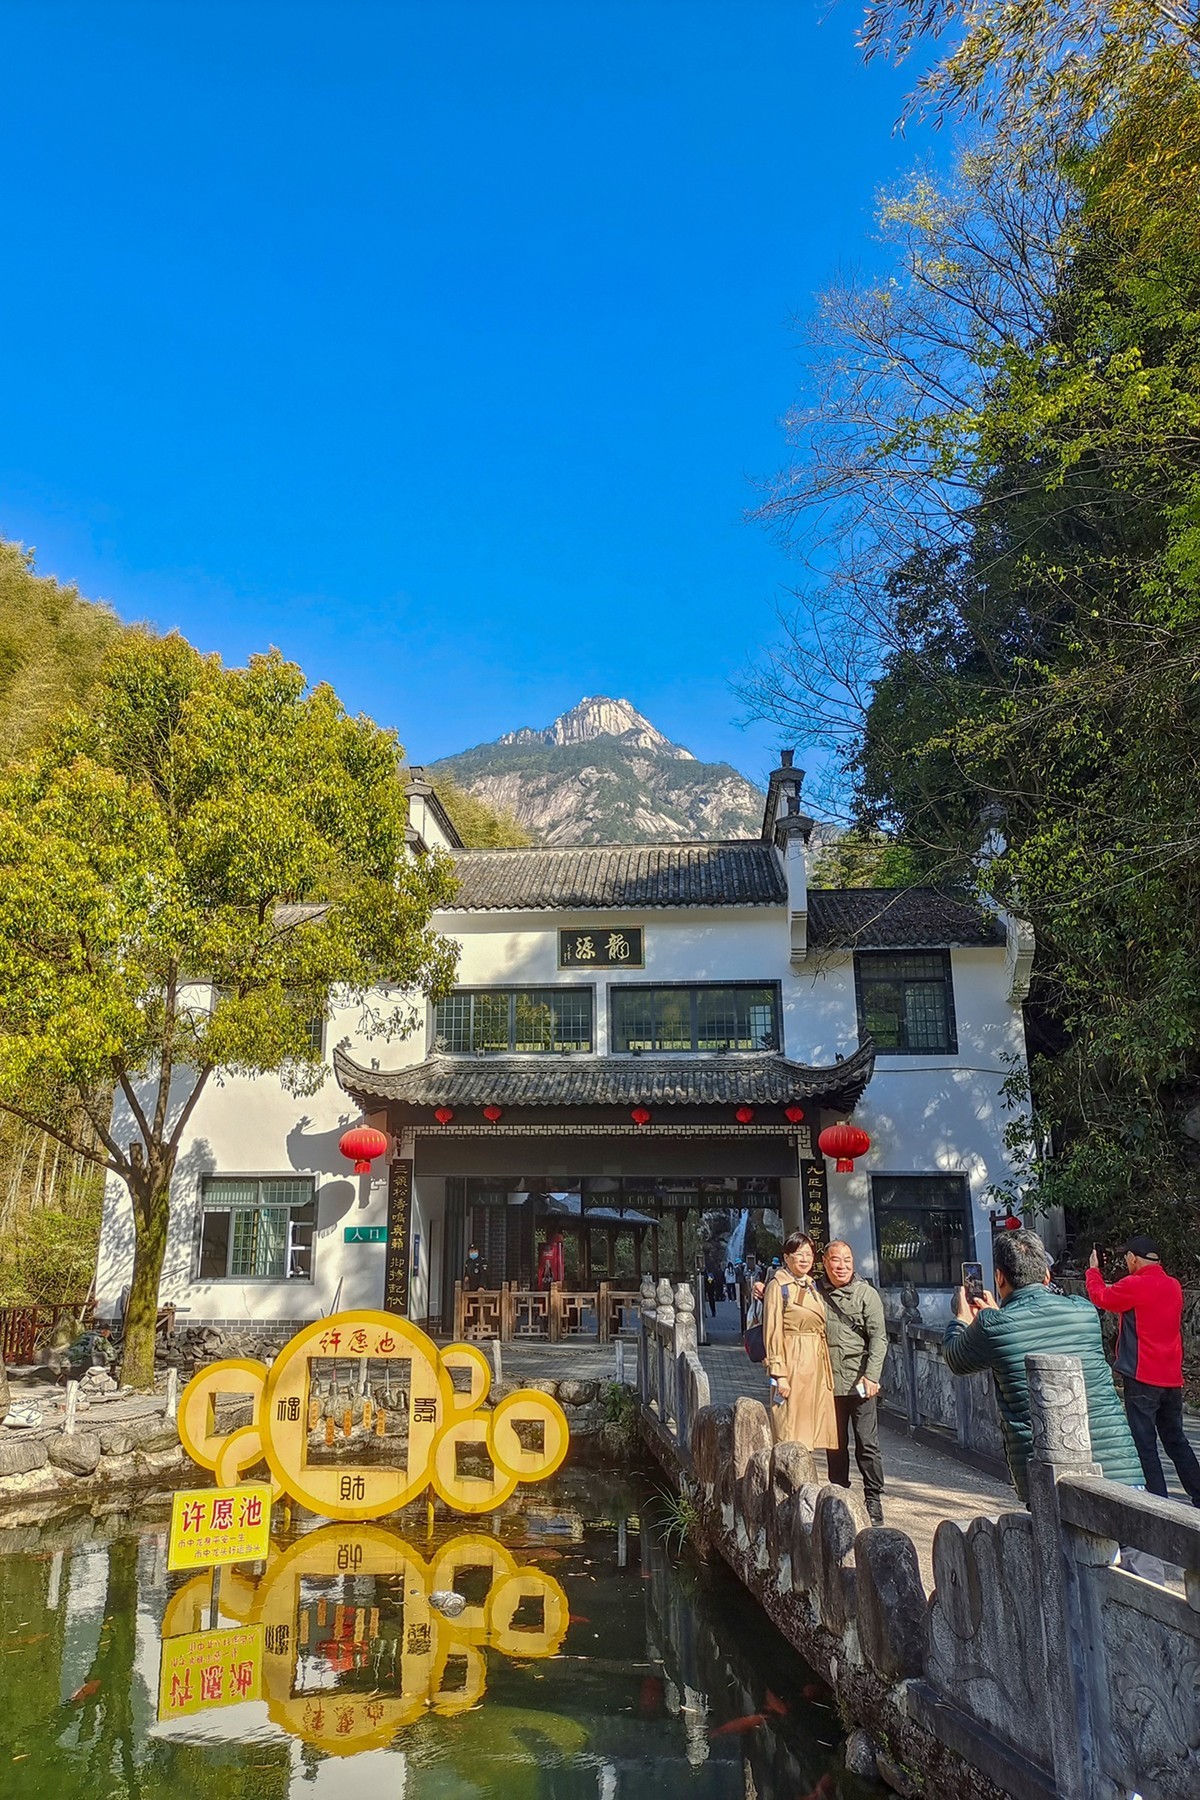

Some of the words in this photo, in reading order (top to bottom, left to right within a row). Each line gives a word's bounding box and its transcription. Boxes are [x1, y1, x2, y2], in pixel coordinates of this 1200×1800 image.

[351, 1227, 379, 1241] 入口
[181, 1495, 263, 1533] 许愿池
